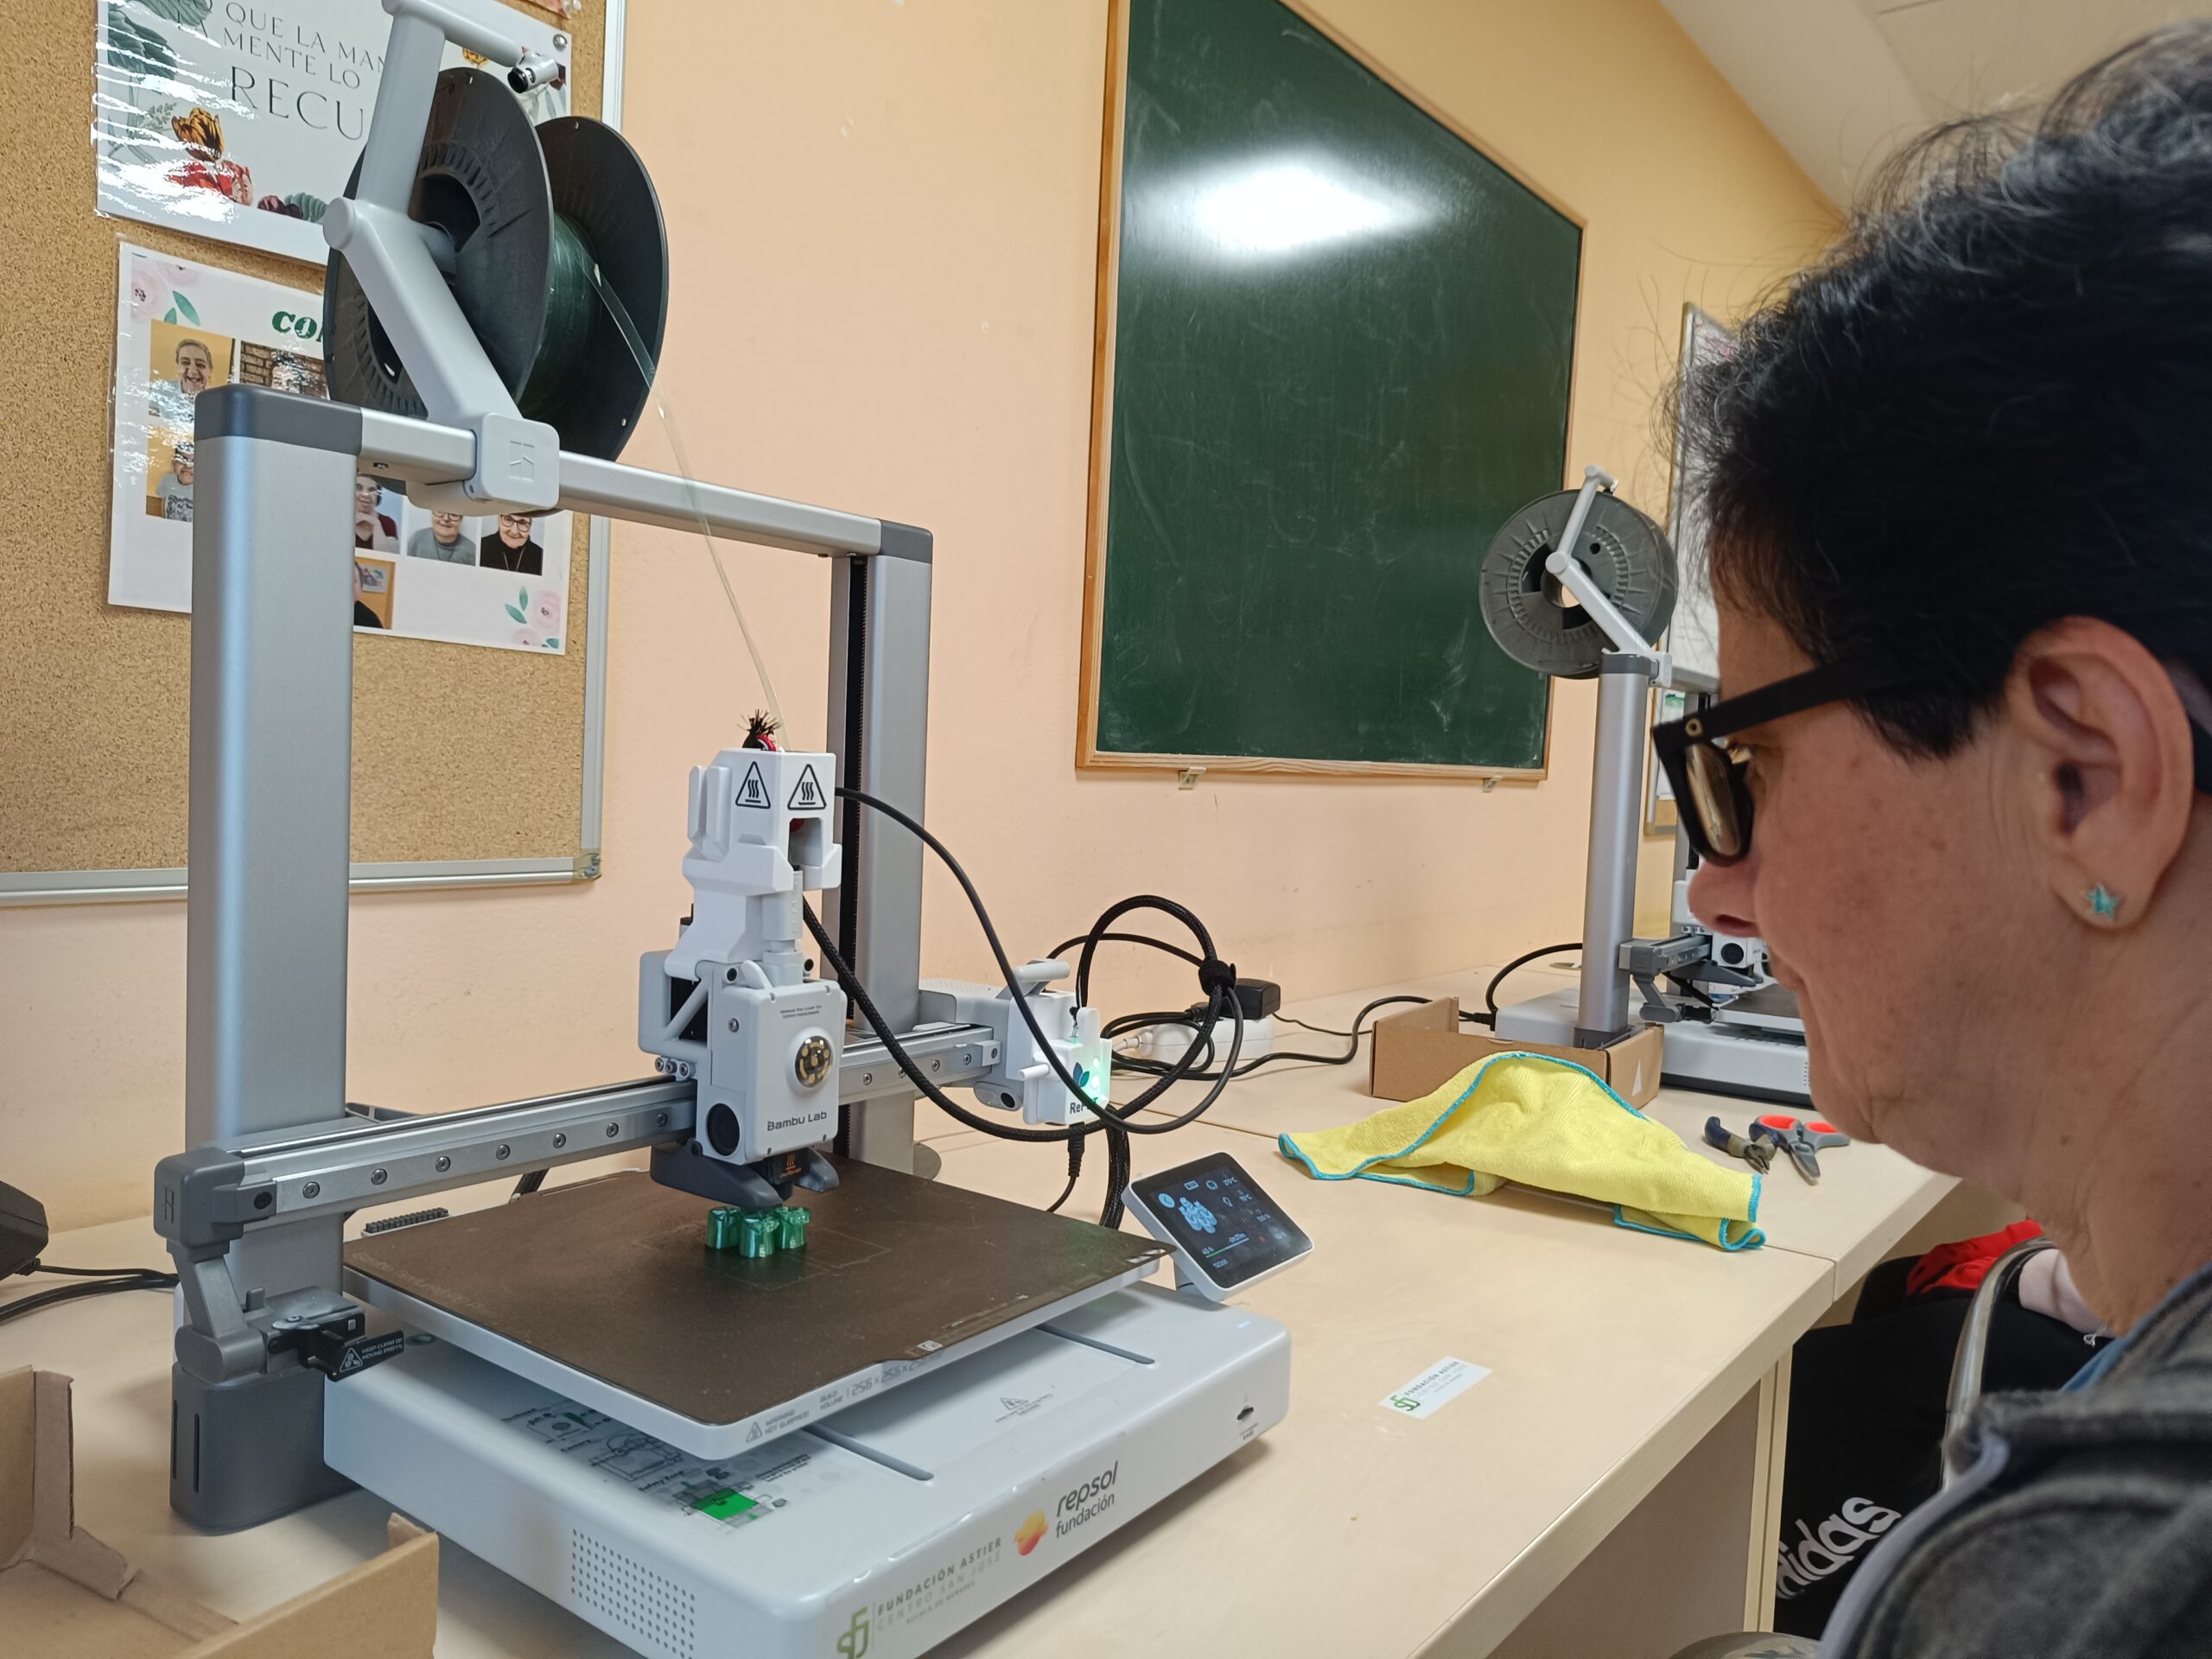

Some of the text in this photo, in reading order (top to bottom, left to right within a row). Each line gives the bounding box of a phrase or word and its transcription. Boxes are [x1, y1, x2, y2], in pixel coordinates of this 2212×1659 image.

[226, 2, 283, 38] QUE
[297, 25, 326, 54] LA
[224, 27, 317, 75] MENTE
[329, 62, 360, 89] LO
[767, 1111, 828, 1131] Bambu Lab
[851, 1377, 873, 1396] 256
[1057, 1460, 1118, 1517] repsol
[1056, 1493, 1115, 1538] fundación
[878, 1537, 1001, 1616] FUNDACIÓN ASTIER
[940, 1573, 964, 1594] SAN
